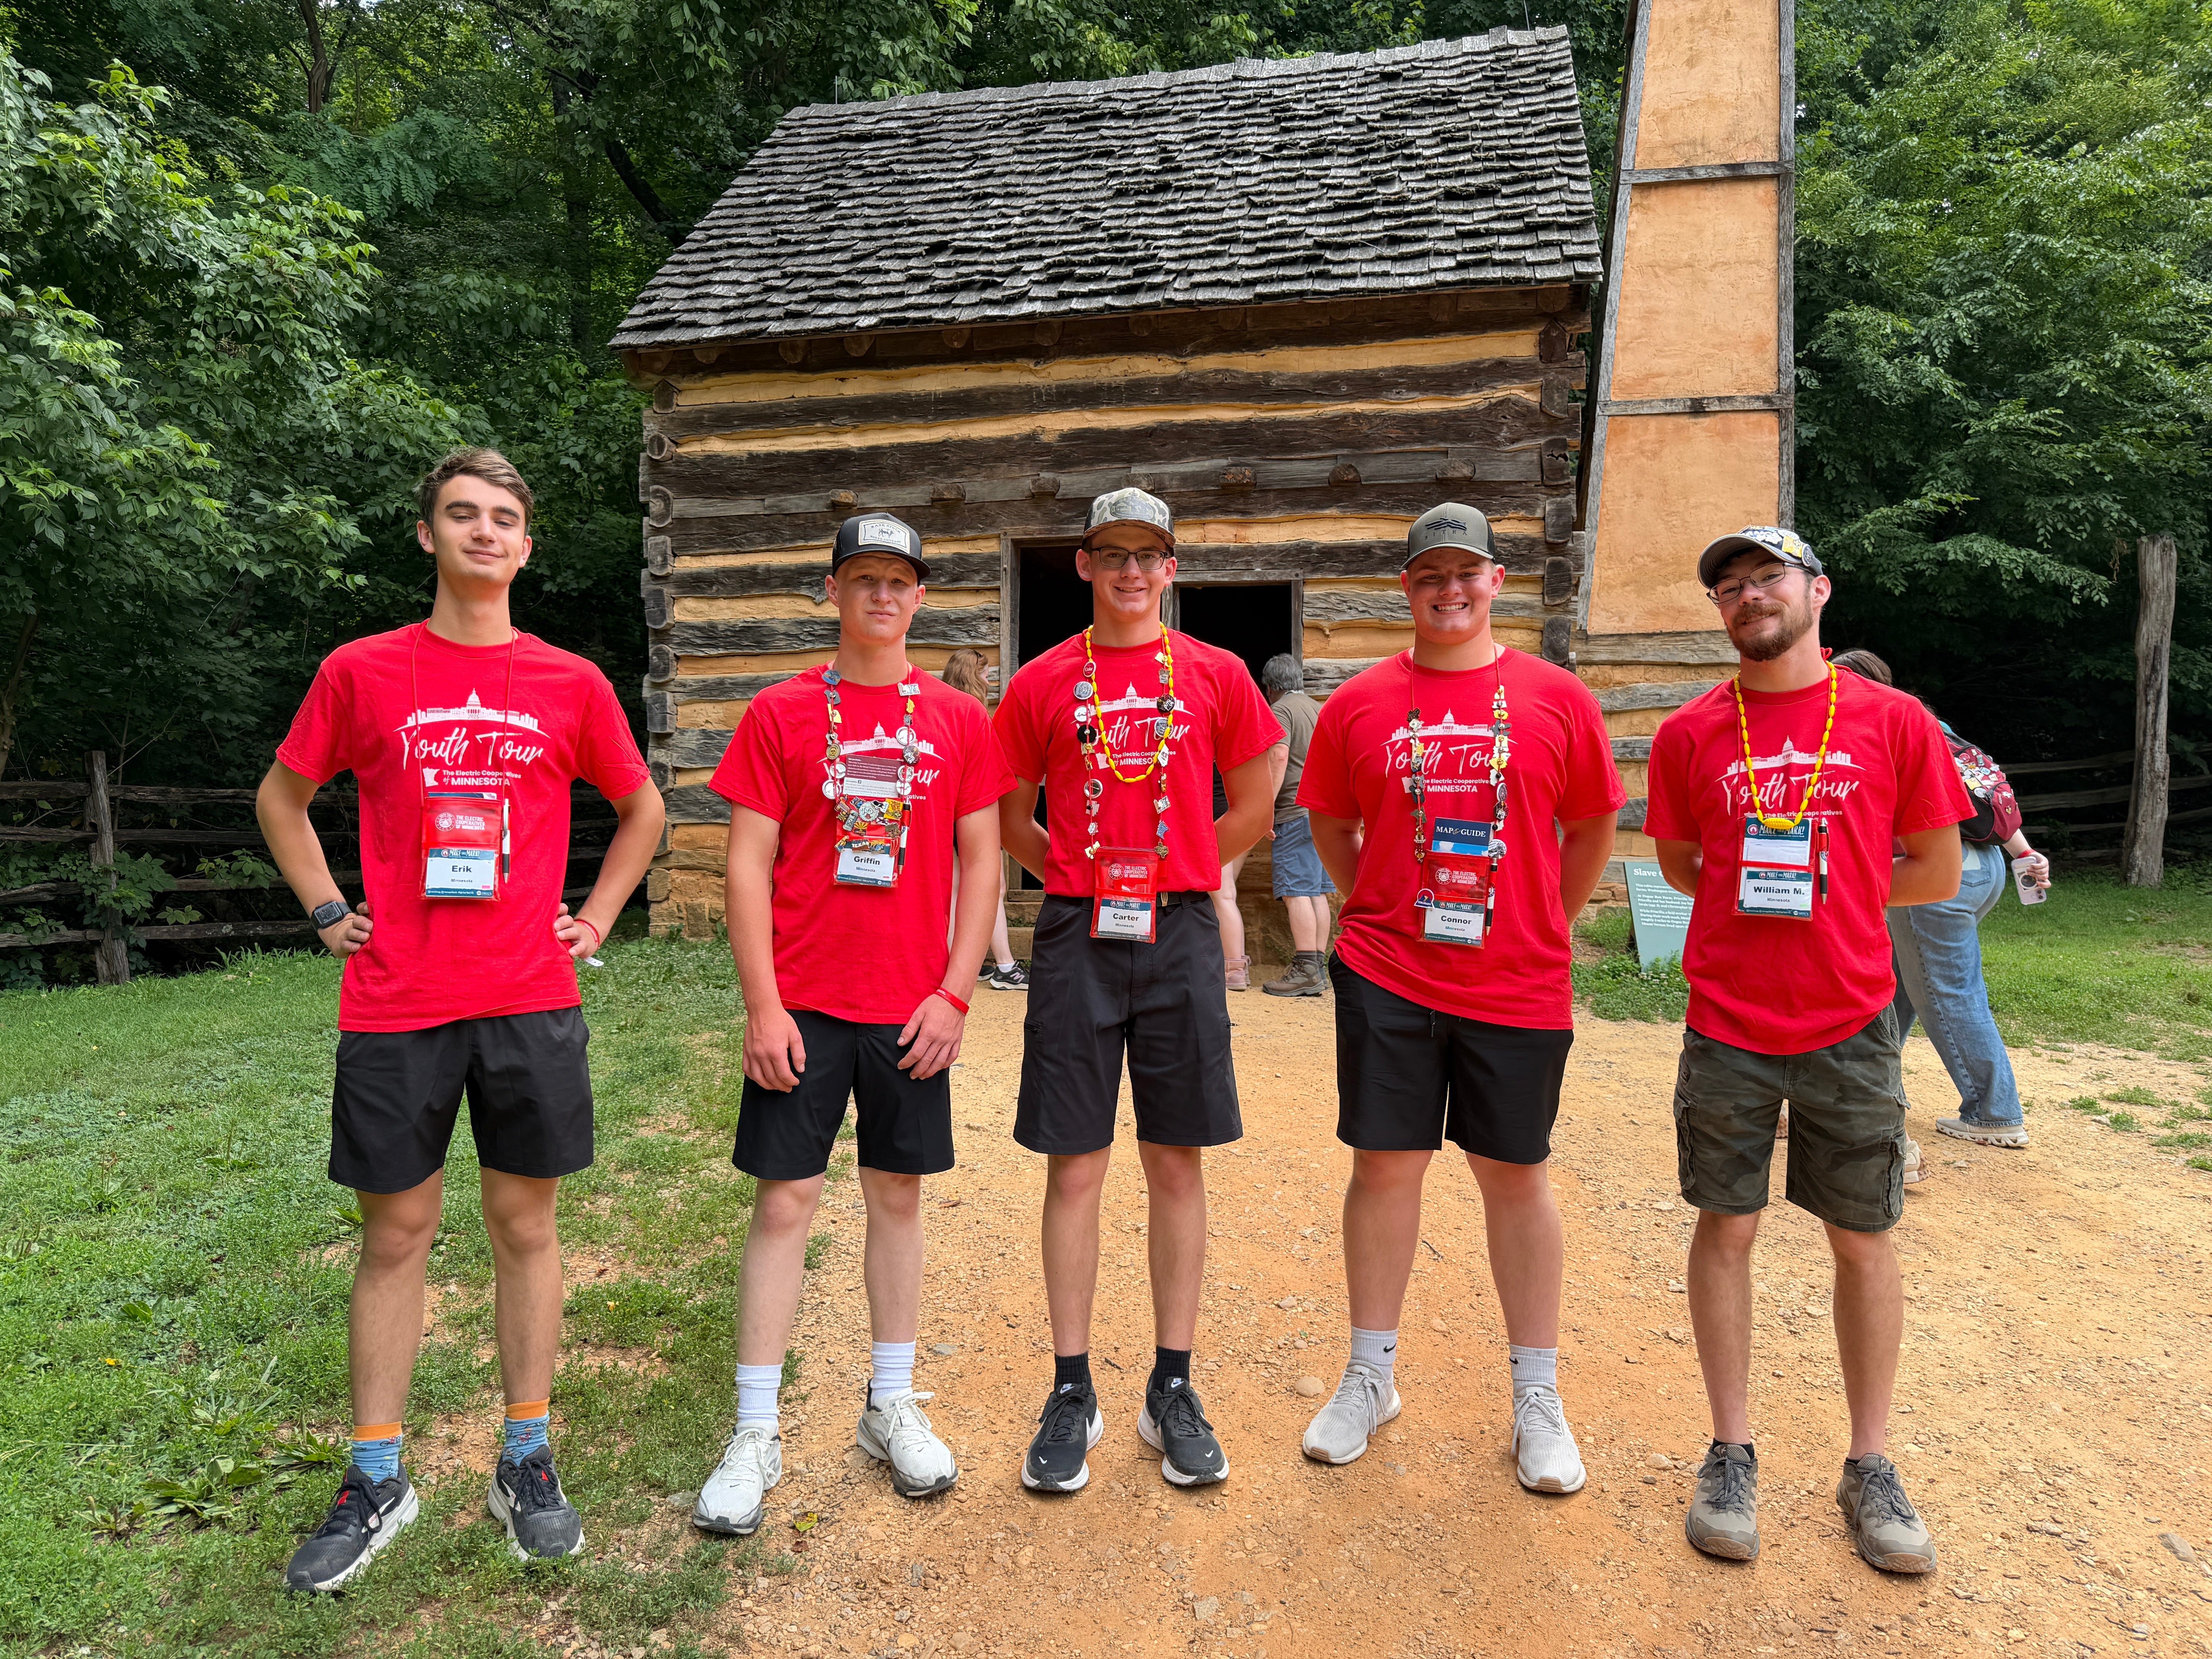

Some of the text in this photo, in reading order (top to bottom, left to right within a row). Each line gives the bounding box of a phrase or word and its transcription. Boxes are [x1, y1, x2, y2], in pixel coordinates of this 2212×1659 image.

[1424, 529, 1467, 540] SITKA
[400, 726, 544, 770] Youth Tour
[1386, 740, 1443, 778] Yoth
[443, 777, 511, 786] of MINNESOTA
[1722, 770, 1860, 816] Youth Tour
[1436, 826, 1454, 834] MAP
[1461, 828, 1486, 837] GUIDE
[854, 856, 880, 865] Griffin
[1633, 868, 1657, 877] Slave
[1753, 886, 1790, 894] William
[1113, 913, 1139, 922] Carter
[1441, 915, 1472, 925] Connor
